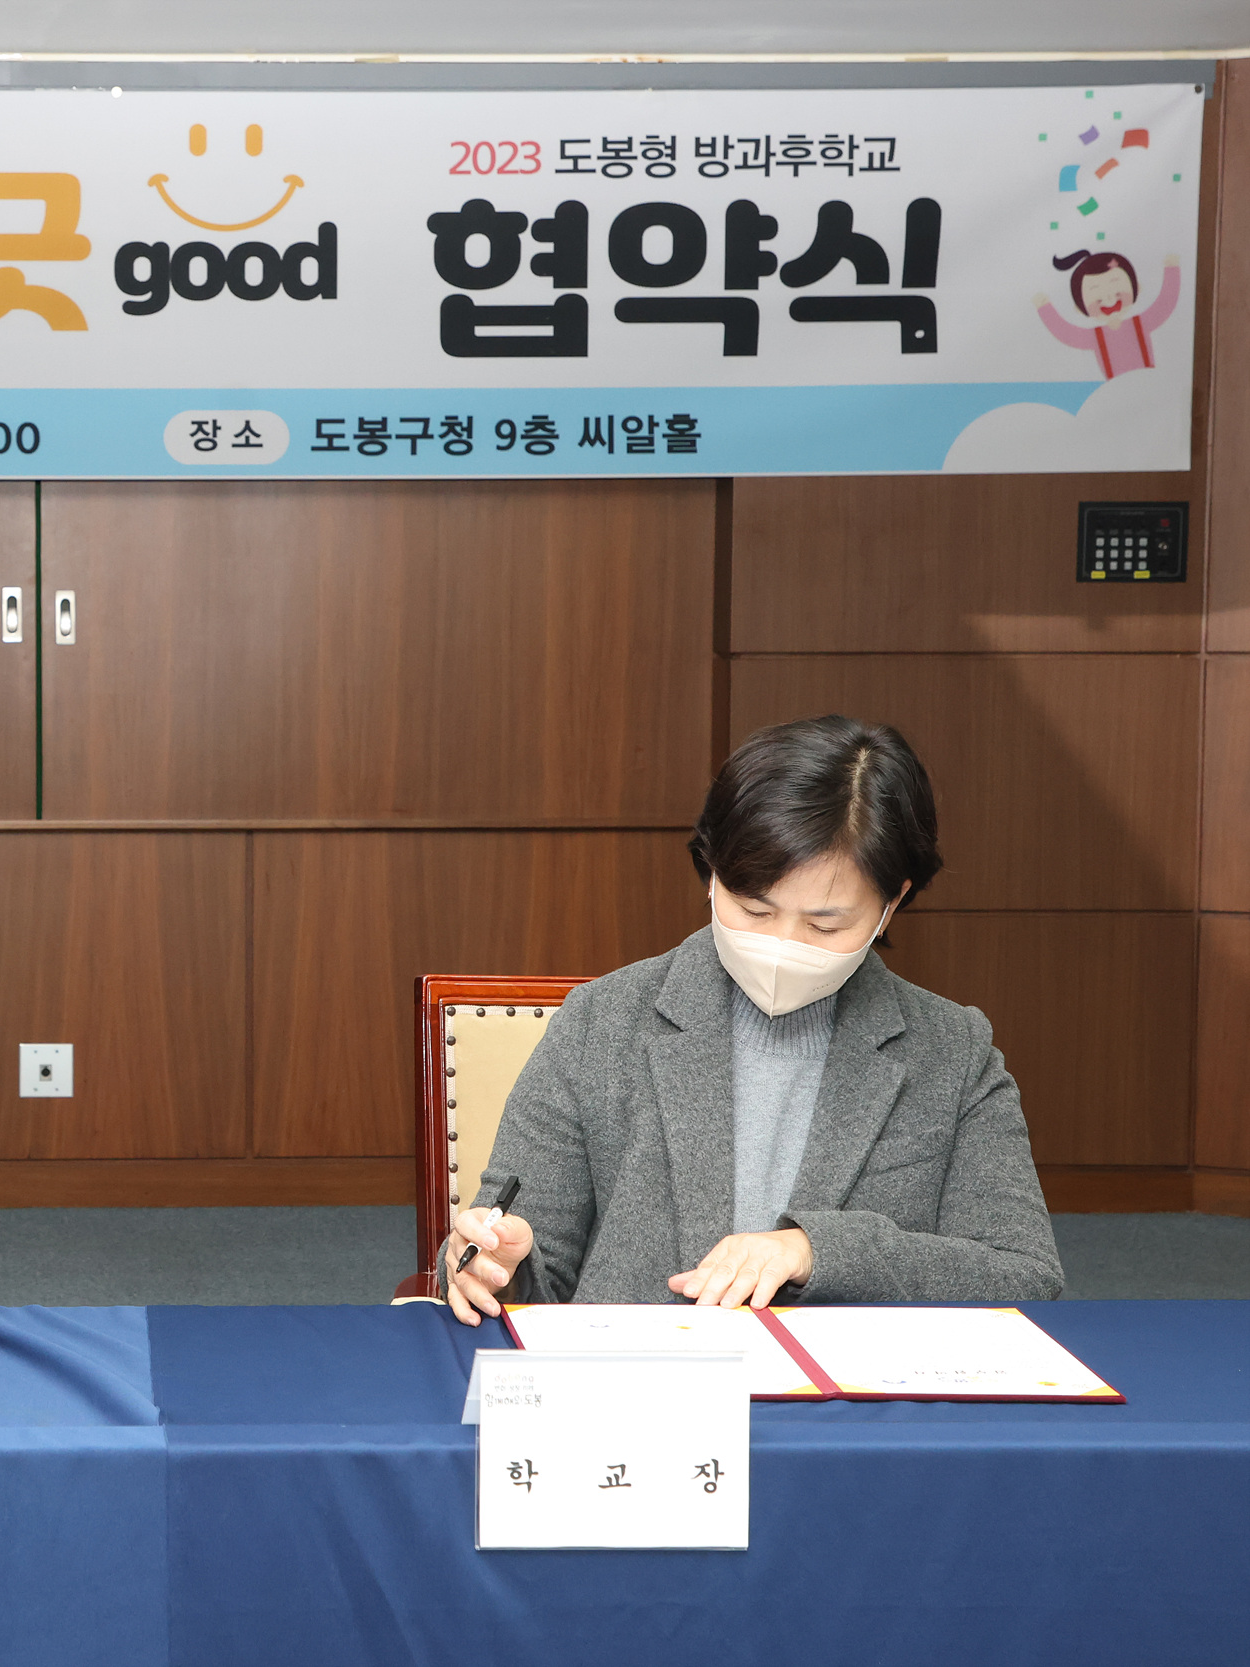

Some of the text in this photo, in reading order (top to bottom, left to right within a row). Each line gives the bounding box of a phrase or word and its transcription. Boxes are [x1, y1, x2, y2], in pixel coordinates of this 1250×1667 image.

[449, 134, 901, 179] 2023 도봉형 방과후학교
[114, 221, 339, 316] good
[426, 197, 942, 358] 협약식
[310, 413, 702, 456] 도봉구청 9층 씨알홀
